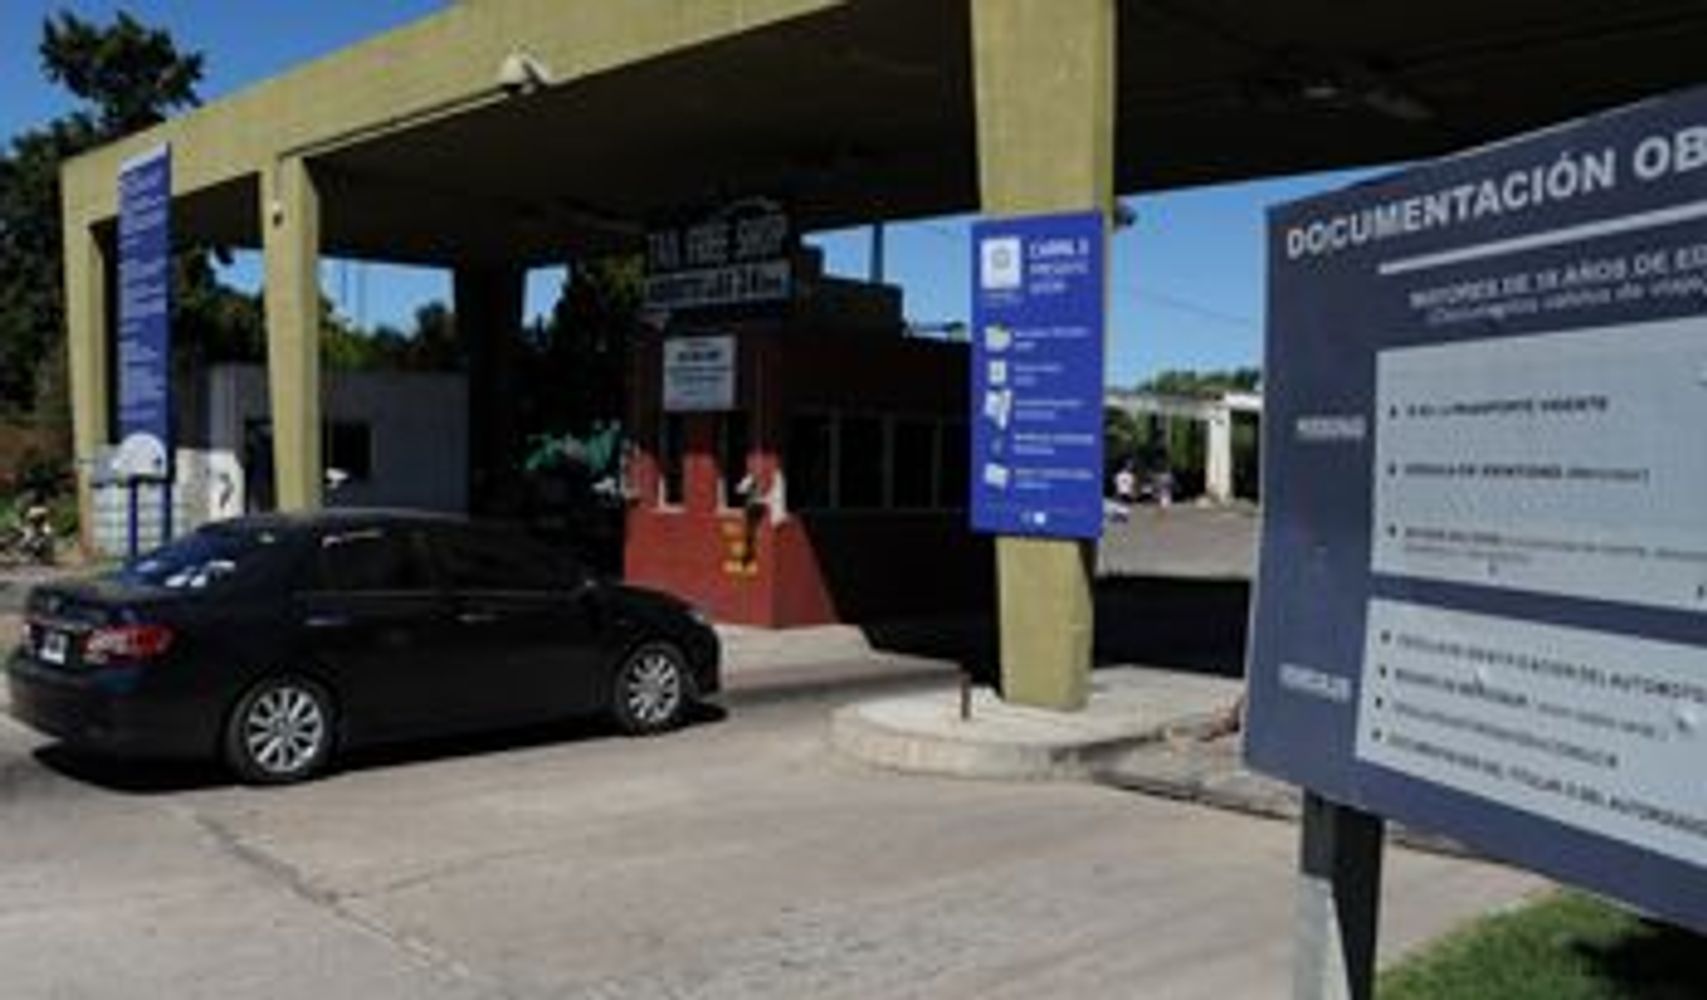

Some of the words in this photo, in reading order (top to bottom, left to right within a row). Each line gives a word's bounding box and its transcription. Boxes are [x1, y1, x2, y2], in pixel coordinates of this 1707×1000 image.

[1287, 149, 1617, 259] DOCUMENTACIÓN
[1634, 126, 1707, 178] OB
[1563, 256, 1627, 286] AÑOS
[1634, 252, 1668, 276] DE
